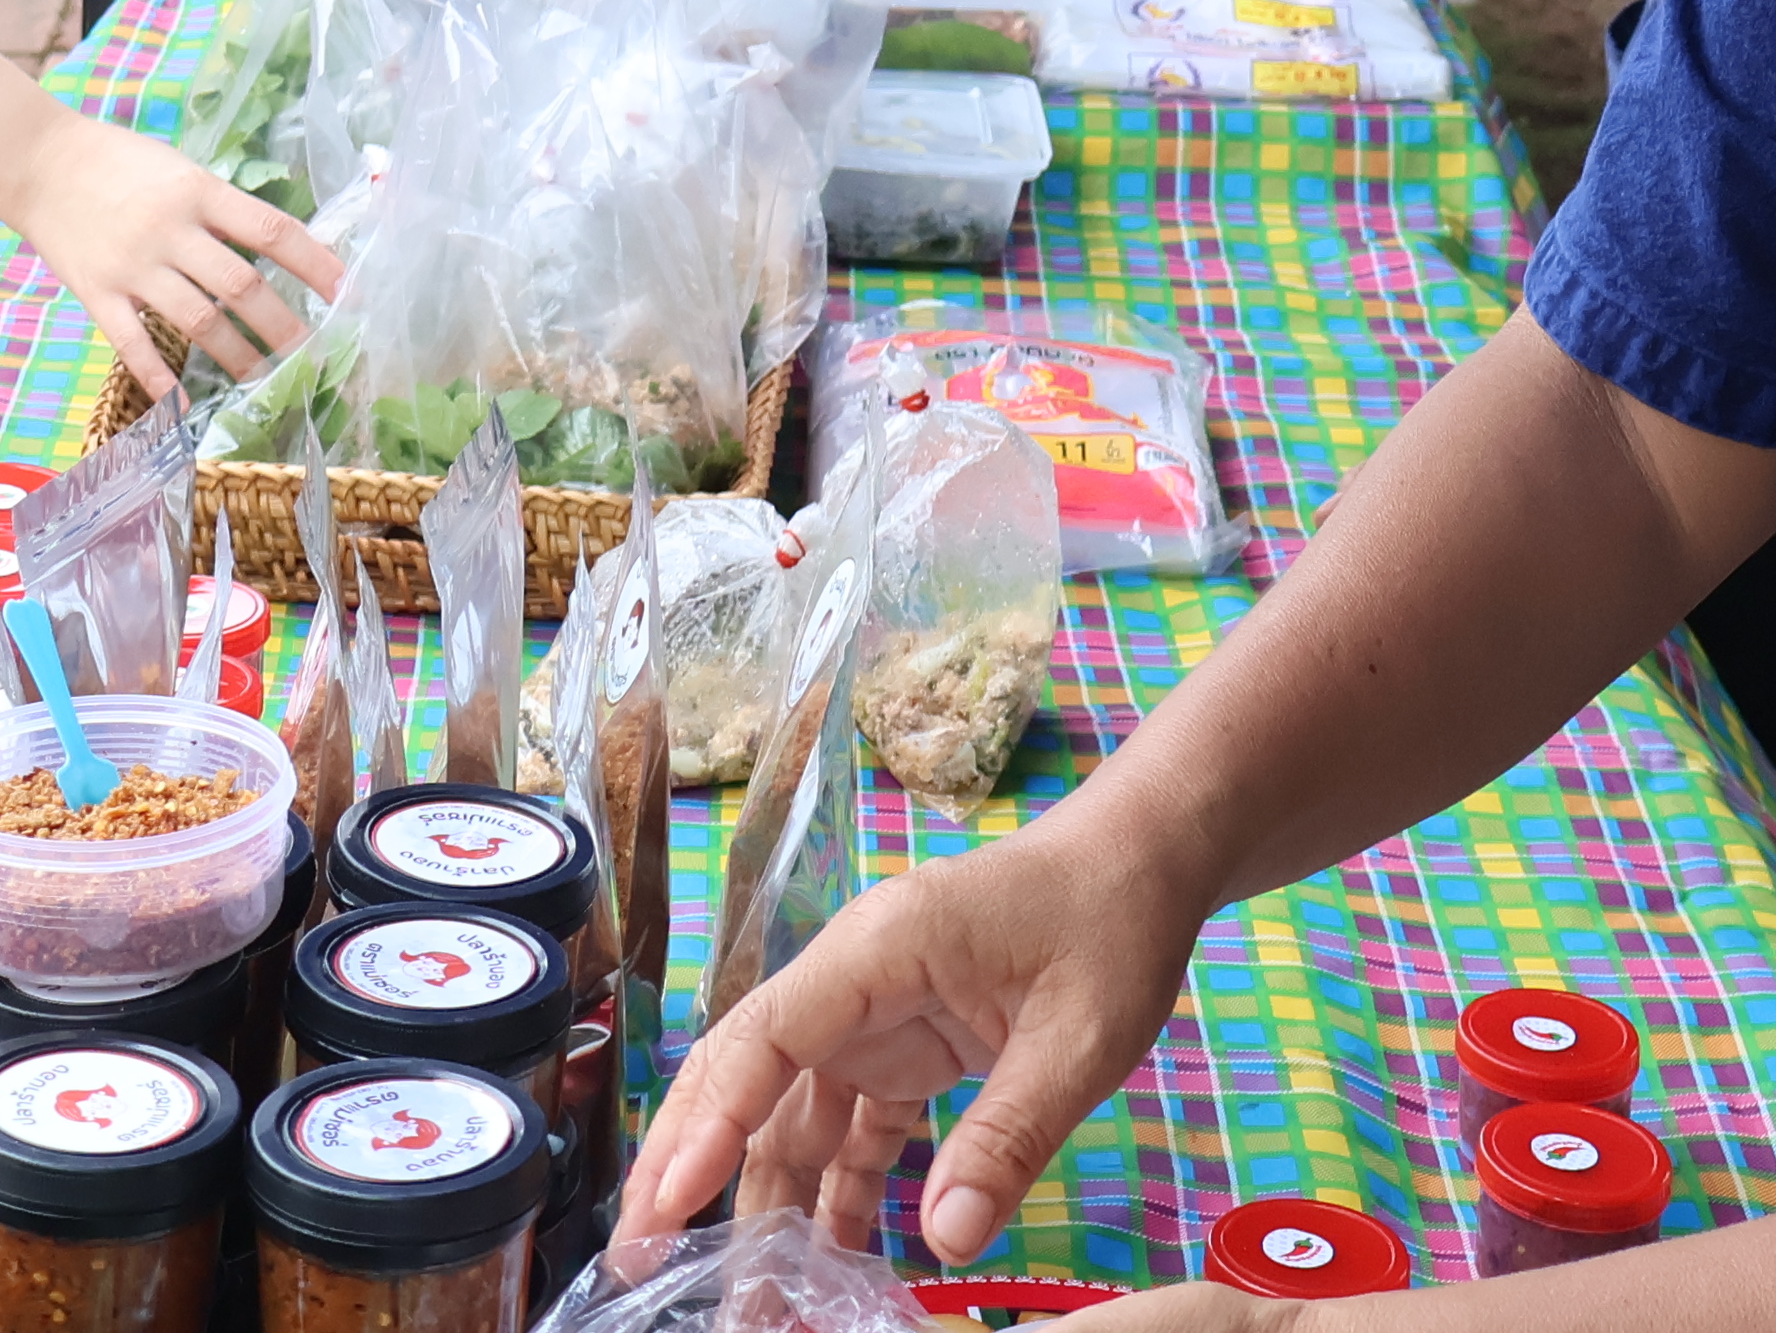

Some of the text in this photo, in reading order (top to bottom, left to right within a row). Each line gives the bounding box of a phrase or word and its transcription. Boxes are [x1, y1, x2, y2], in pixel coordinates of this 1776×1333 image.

[398, 849, 516, 878] ปลาร้าบอง
[456, 932, 507, 990] ปลาร้าบอง
[11, 1063, 71, 1127] ปลาร้าบอง
[405, 1114, 489, 1173] ปลาร้าบอง
